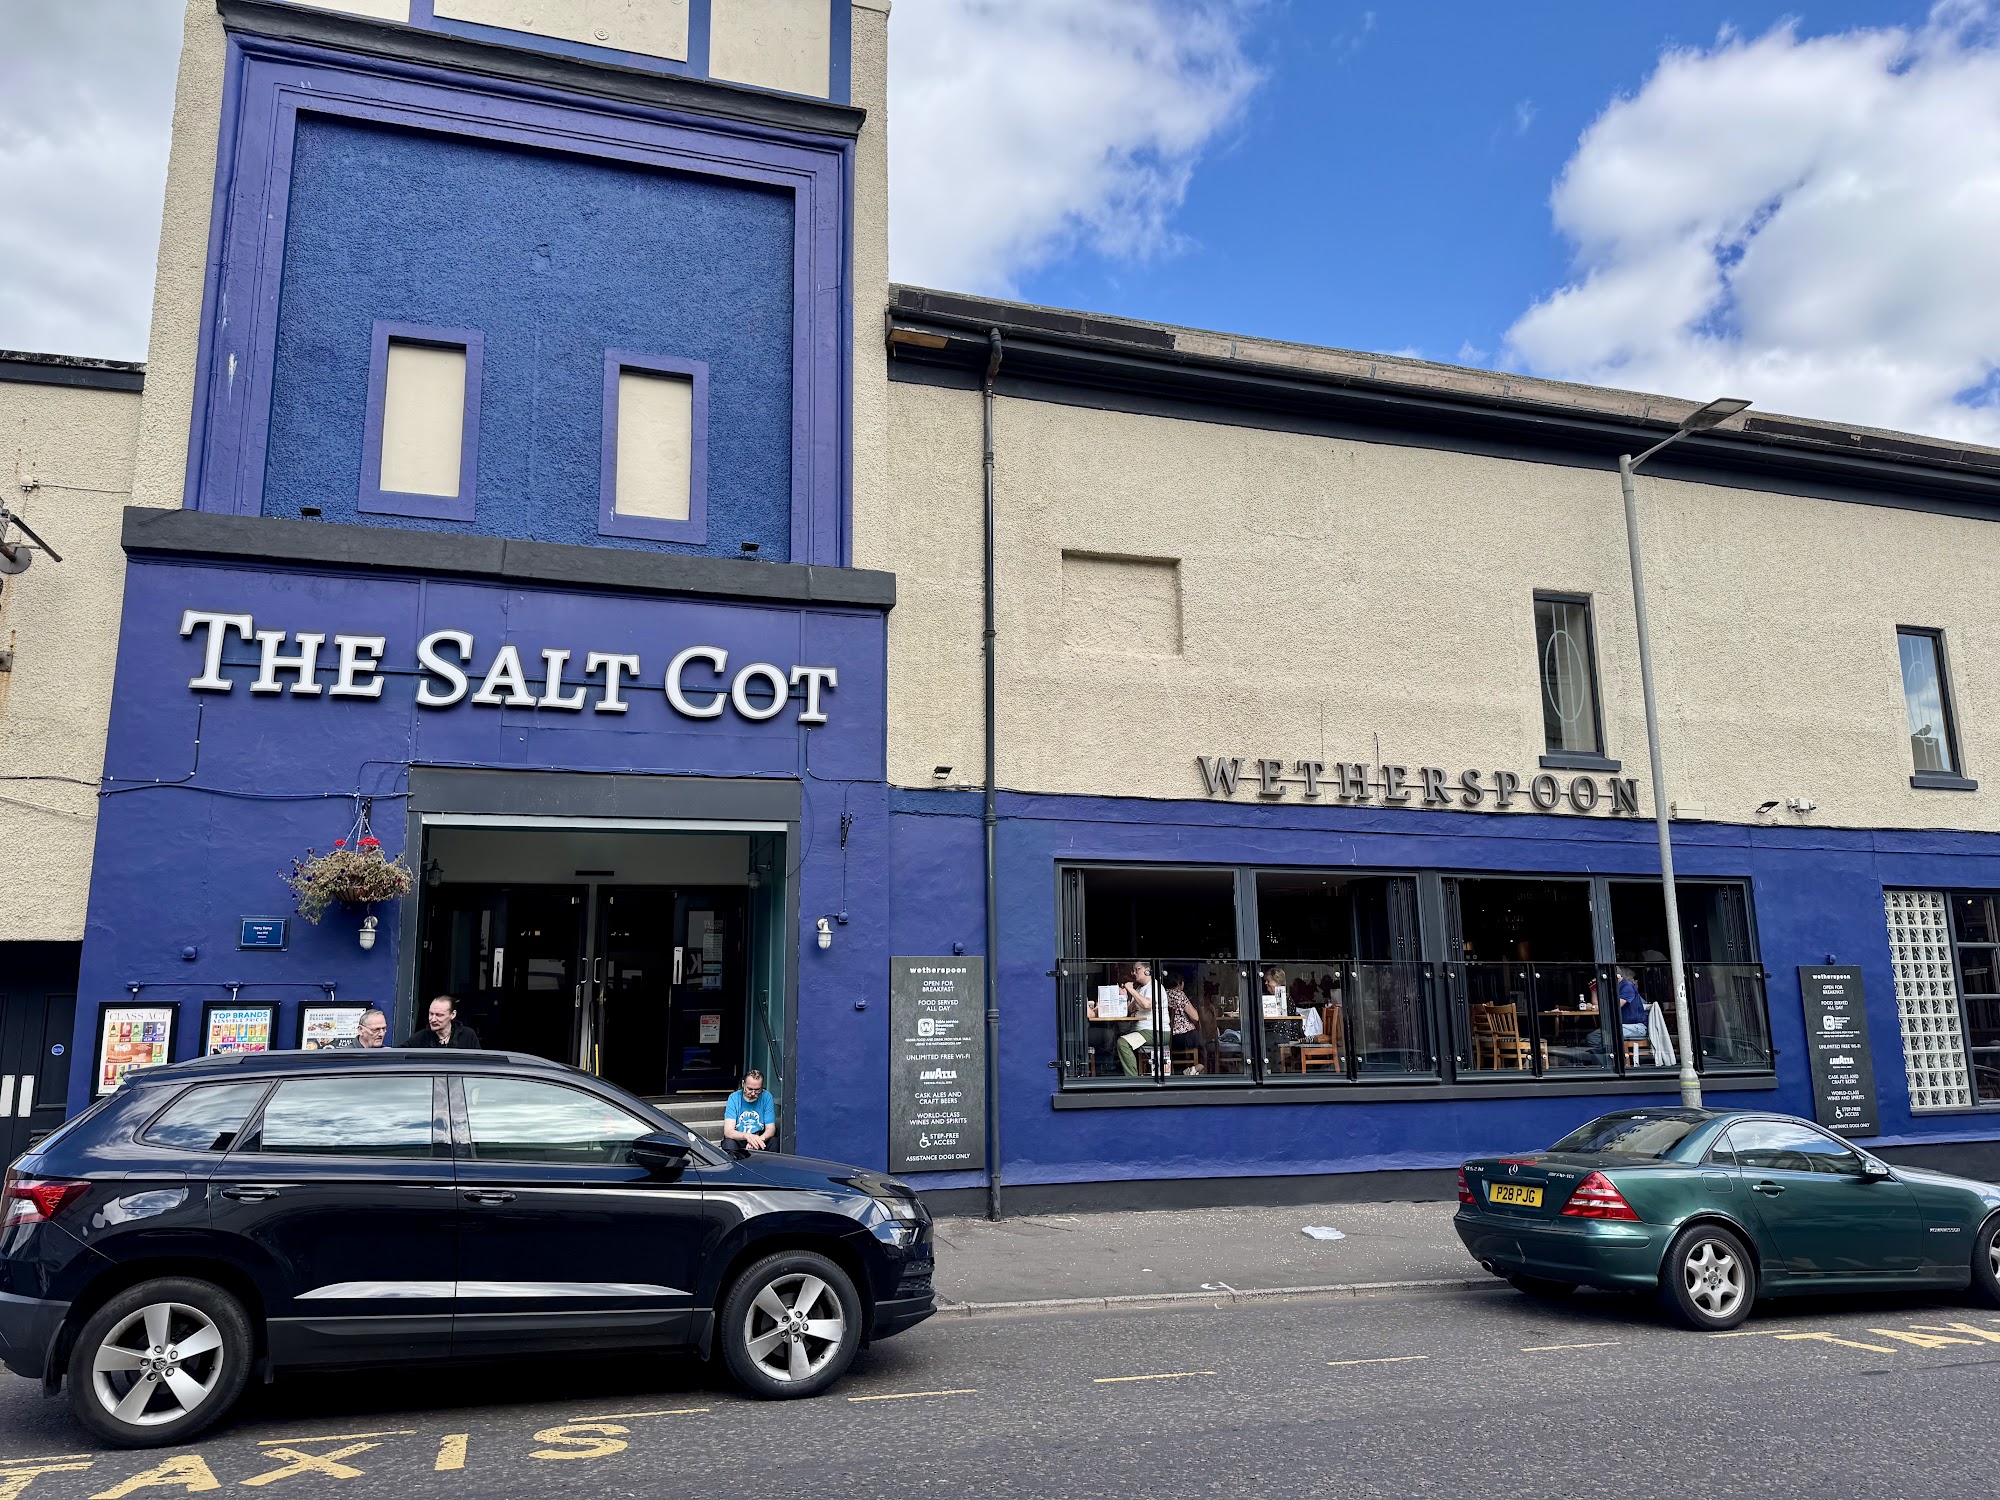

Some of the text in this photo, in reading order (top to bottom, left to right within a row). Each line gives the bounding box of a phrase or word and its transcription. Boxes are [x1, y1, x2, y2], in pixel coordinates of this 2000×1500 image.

[179, 609, 838, 722] THE SALT COT
[1198, 756, 1639, 814] WETHERSPOON
[109, 1012, 168, 1020] CLASS ACT
[920, 1068, 957, 1079] LAVAZZA
[1496, 1186, 1535, 1203] P28 PJG
[1773, 1322, 2000, 1353] TAX
